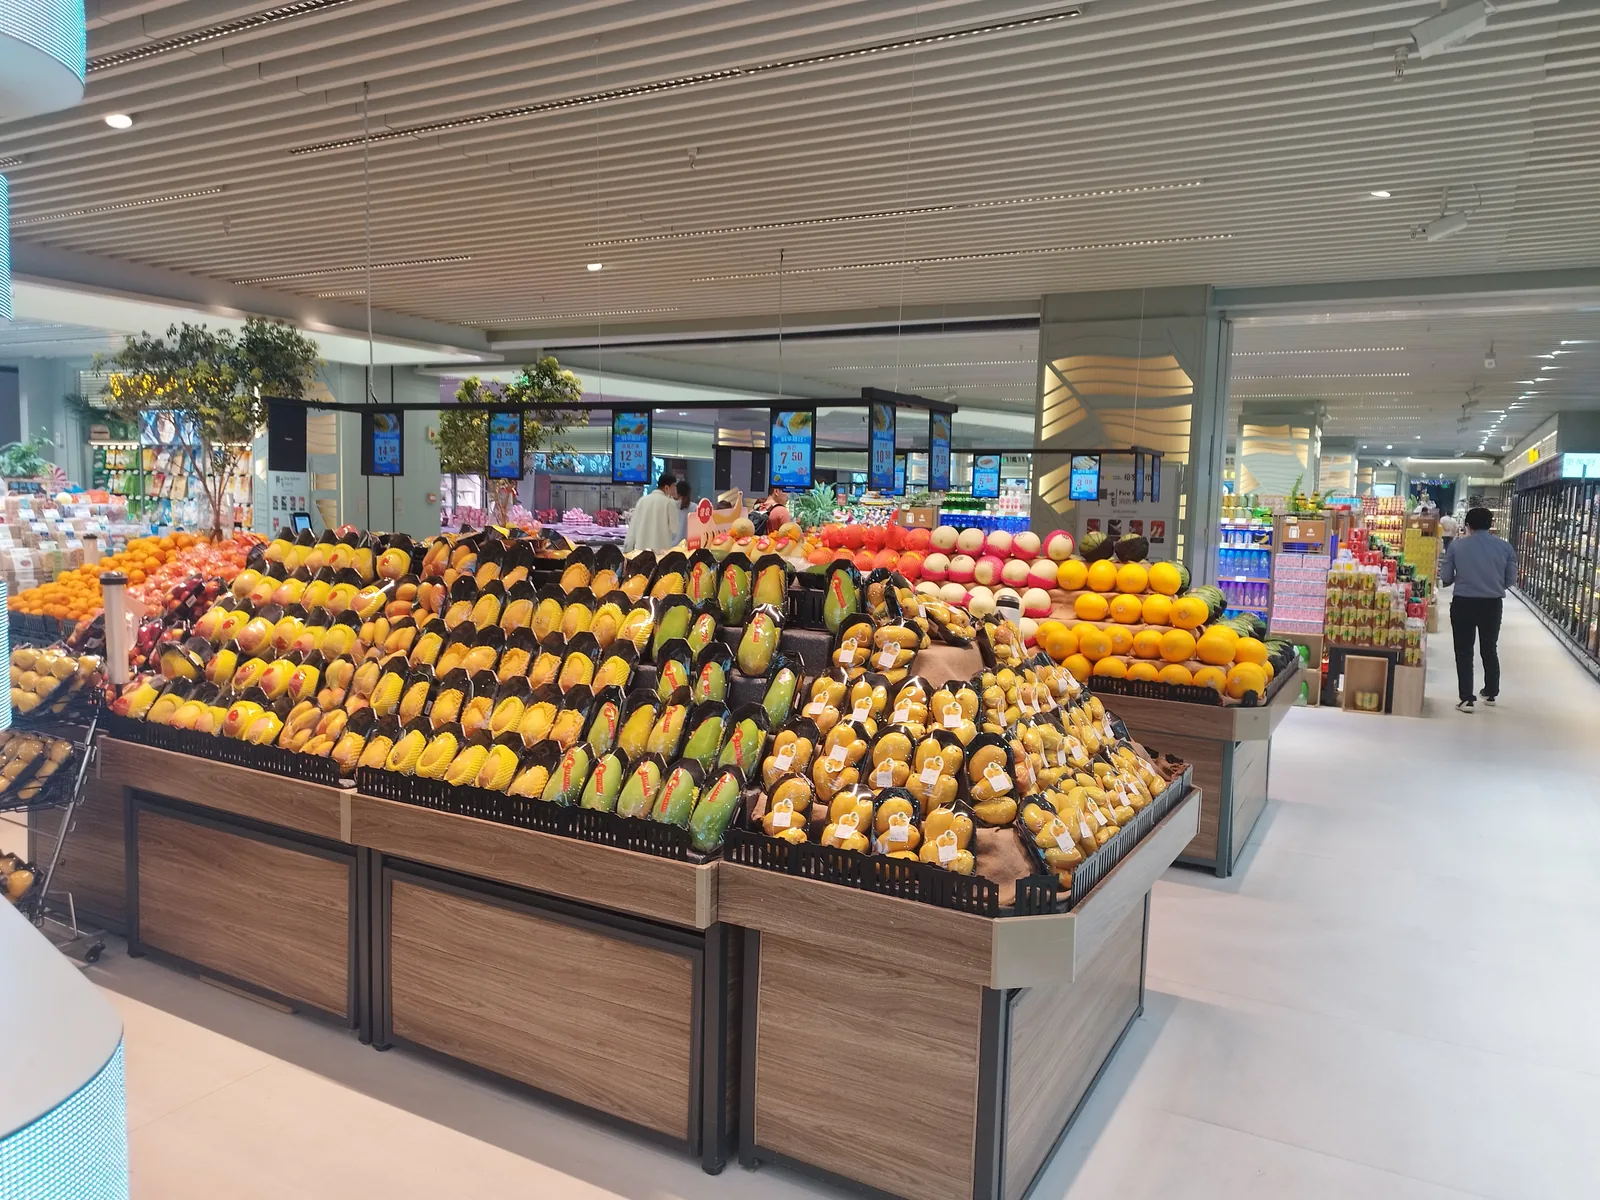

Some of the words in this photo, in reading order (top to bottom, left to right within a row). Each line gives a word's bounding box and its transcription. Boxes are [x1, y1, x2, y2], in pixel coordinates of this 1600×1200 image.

[378, 446, 388, 456] 14
[496, 447, 503, 459] 8
[504, 447, 514, 456] 50
[619, 450, 632, 461] 12
[634, 450, 643, 458] 50
[876, 450, 884, 463] 10
[780, 451, 788, 464] 7
[791, 451, 803, 462] 50
